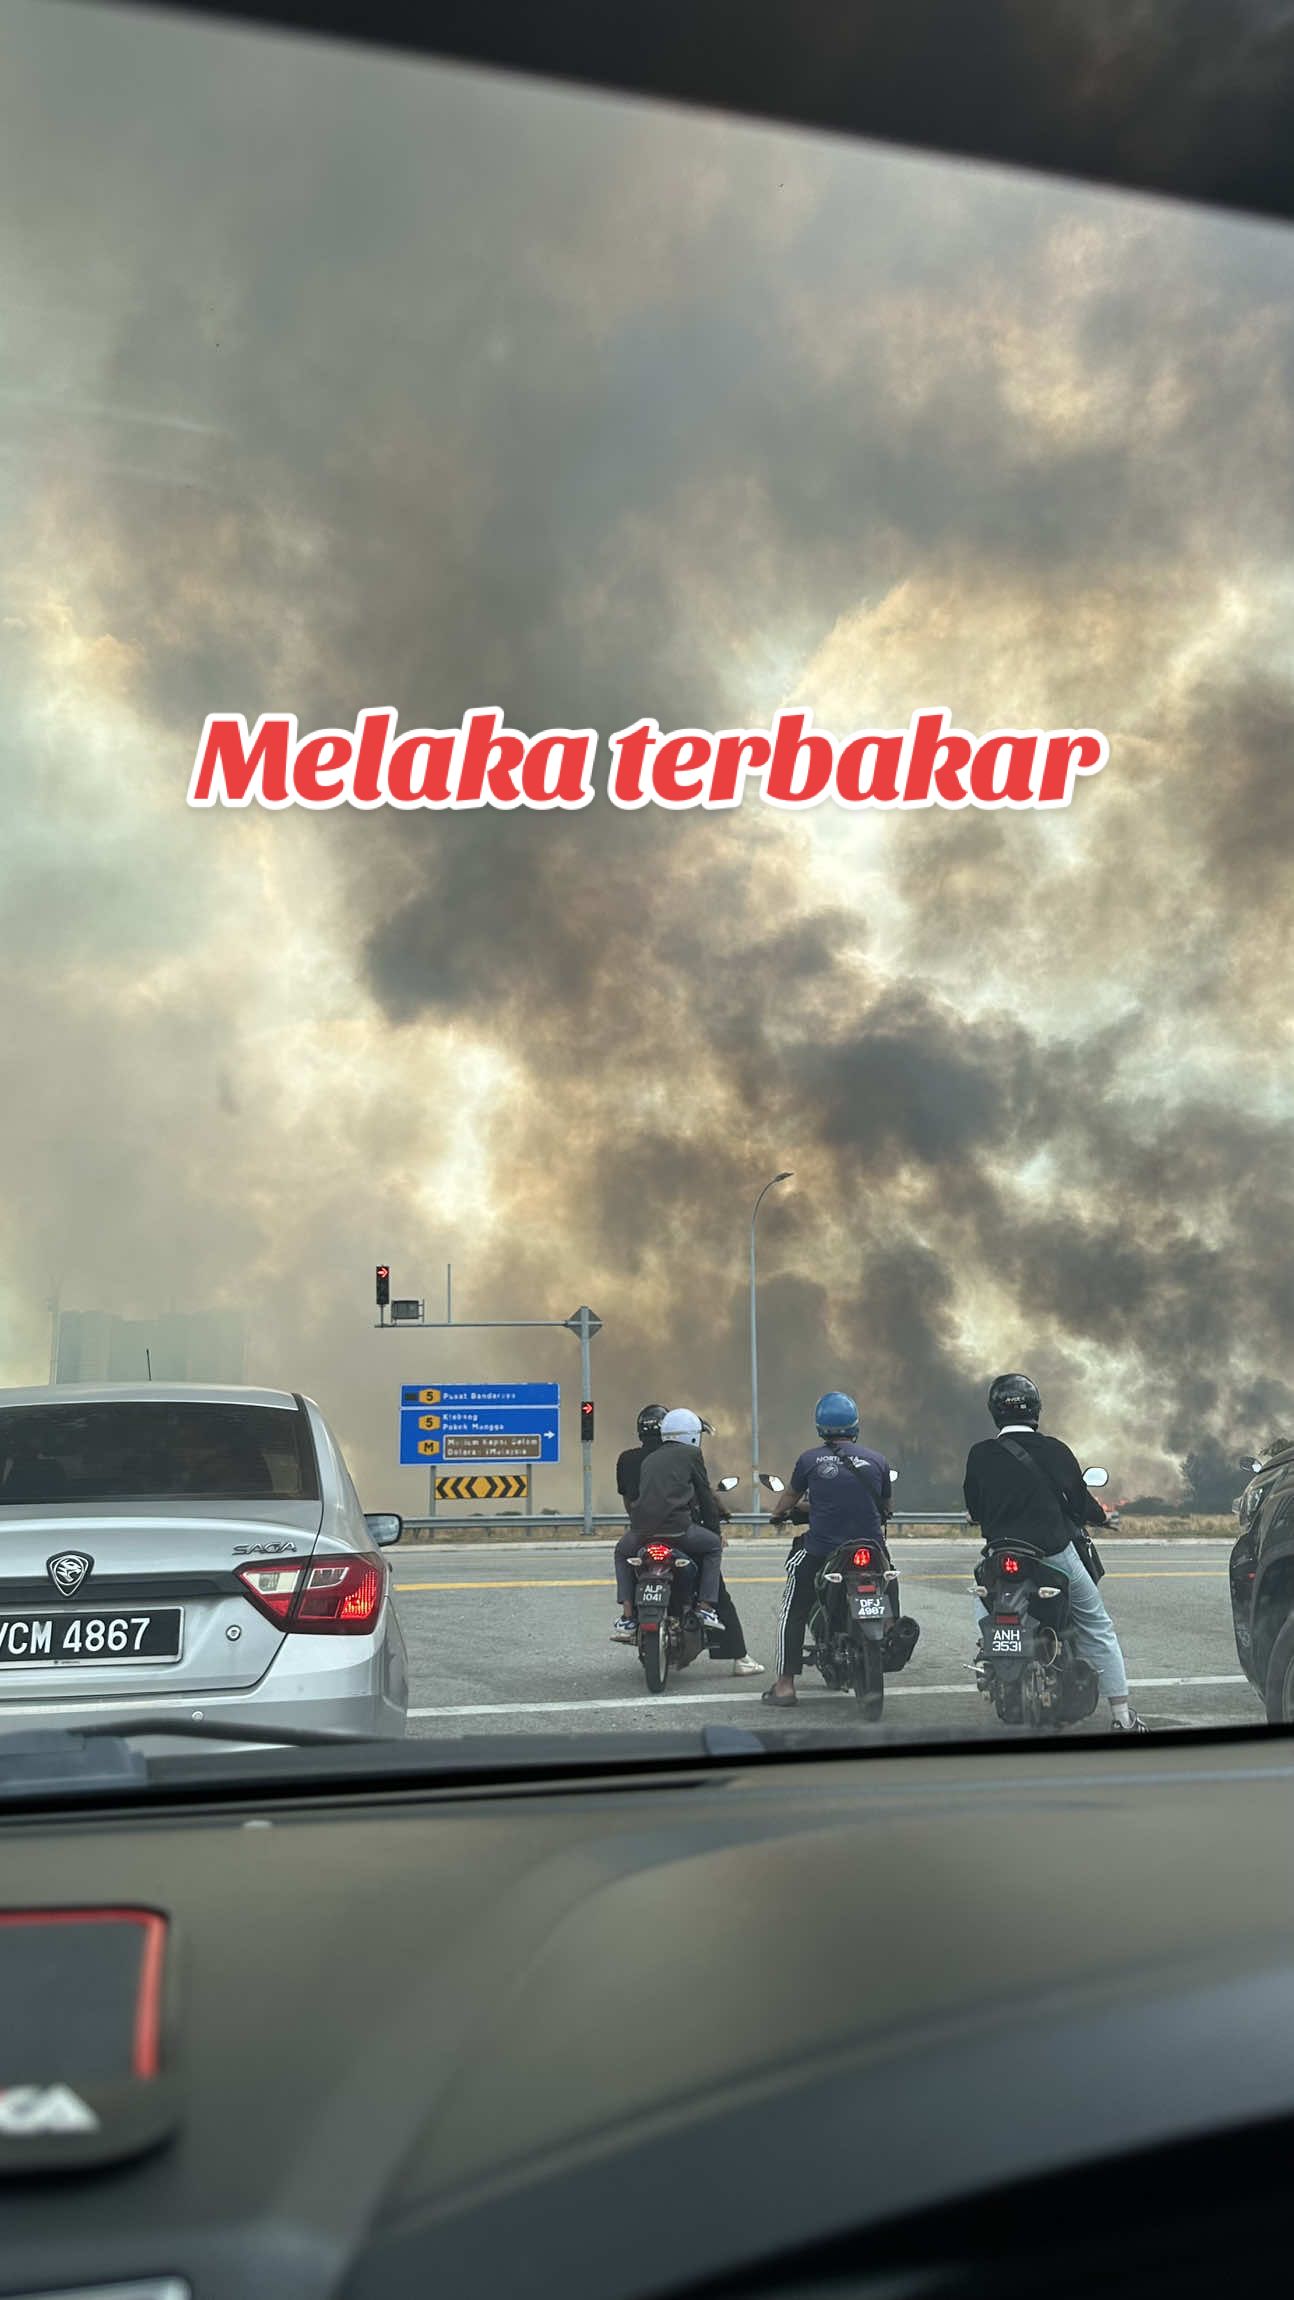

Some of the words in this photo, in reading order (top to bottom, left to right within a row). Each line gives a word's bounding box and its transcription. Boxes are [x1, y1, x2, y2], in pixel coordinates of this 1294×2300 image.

[426, 1392, 434, 1401] 5
[425, 1417, 433, 1427] 5
[423, 1443, 433, 1452] M
[231, 1541, 297, 1556] SAGA
[644, 1584, 663, 1593] ALP
[859, 1599, 880, 1608] DFJ
[62, 1617, 151, 1653] 4867
[993, 1629, 1020, 1641] ANH
[992, 1640, 1022, 1652] 3531
